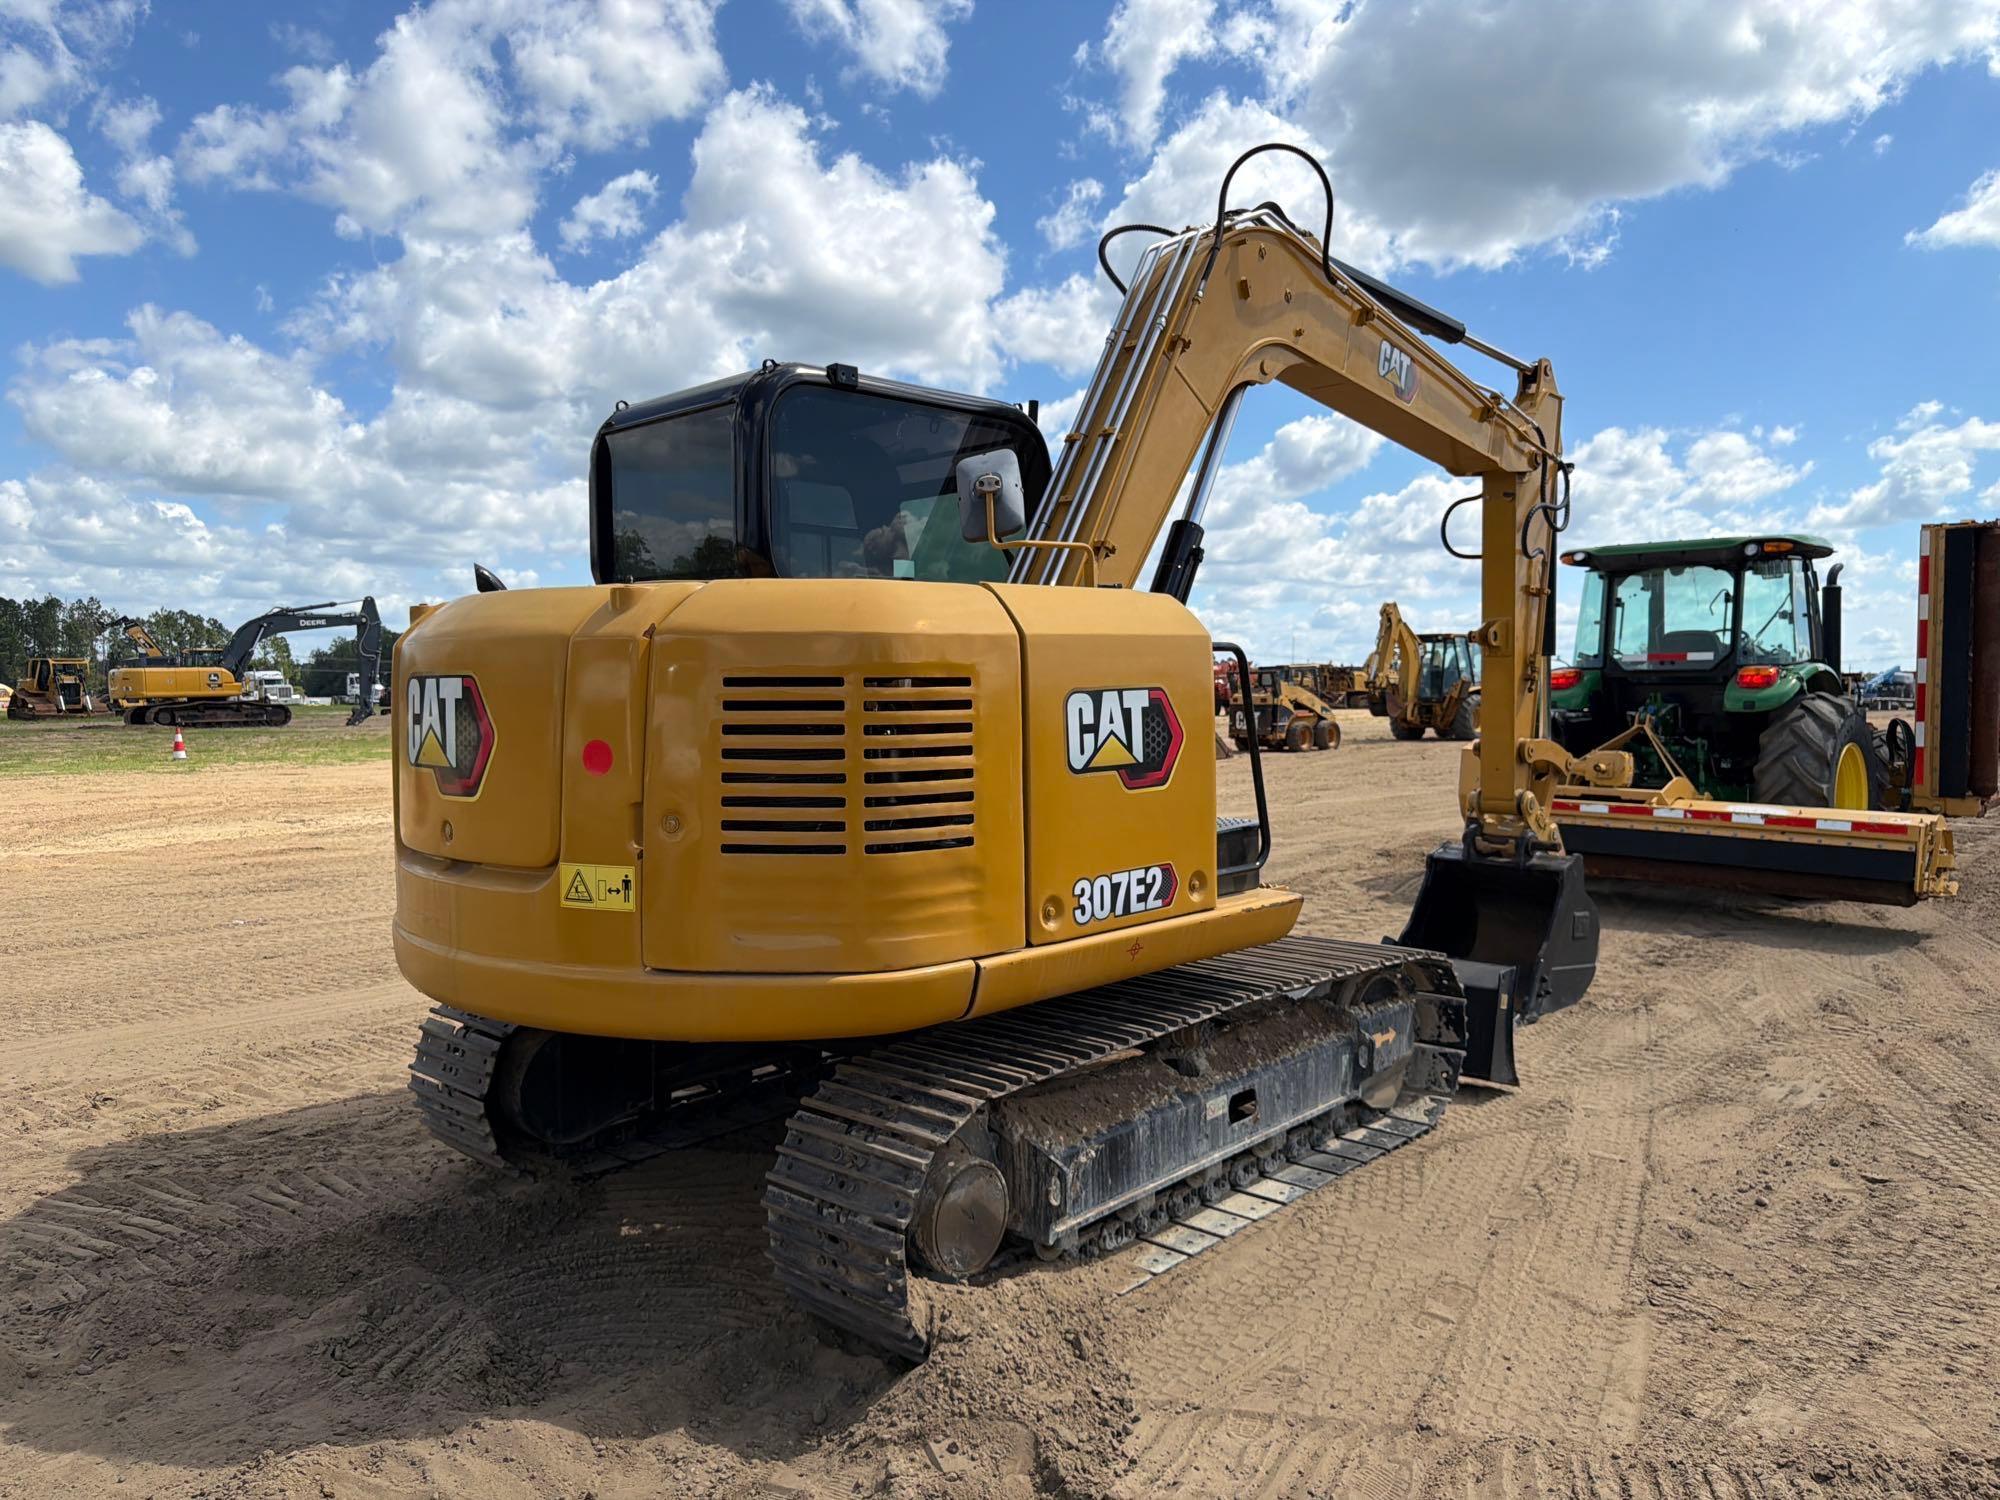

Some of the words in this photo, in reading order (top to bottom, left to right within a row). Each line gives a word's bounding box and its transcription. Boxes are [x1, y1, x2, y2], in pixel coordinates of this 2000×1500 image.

[1378, 340, 1412, 390] CAT
[299, 619, 327, 627] DEERE
[408, 677, 463, 768] CAT
[1066, 689, 1150, 770] CAT
[1235, 711, 1261, 730] CT
[1074, 866, 1163, 925] 307E2
